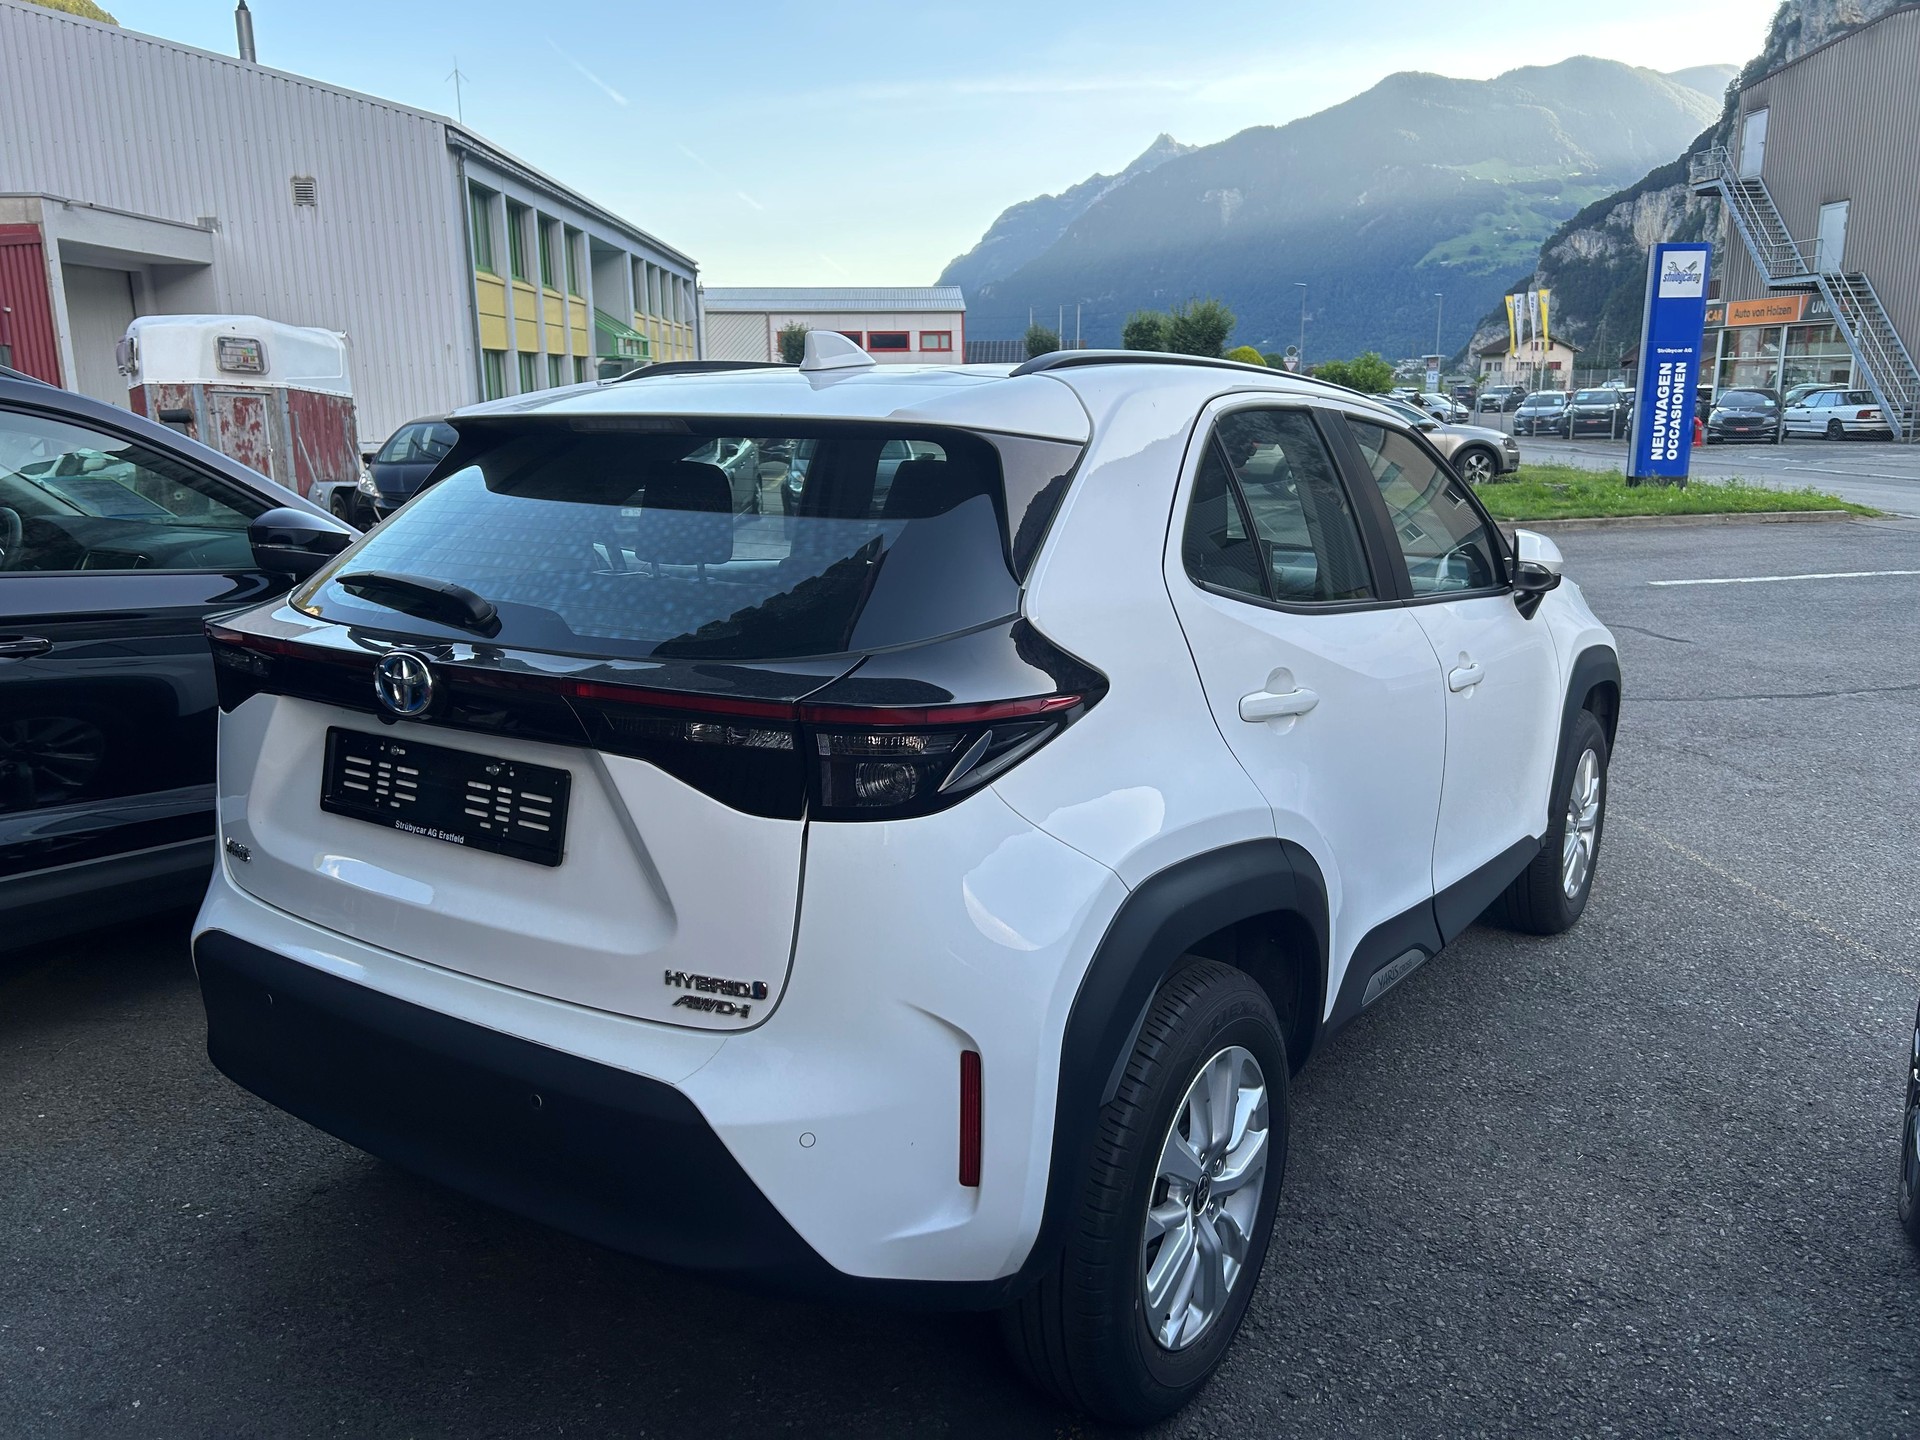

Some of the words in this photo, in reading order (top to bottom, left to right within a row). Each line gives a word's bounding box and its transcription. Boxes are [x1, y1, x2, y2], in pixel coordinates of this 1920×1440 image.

[1734, 308, 1751, 319] Auto
[1752, 308, 1765, 318] von
[1651, 362, 1672, 460] NEUWAGEN
[1666, 362, 1687, 460] OCCASIONEN
[427, 827, 437, 837] AG
[438, 830, 464, 844] Erstfeld
[665, 969, 751, 998] HYBRID
